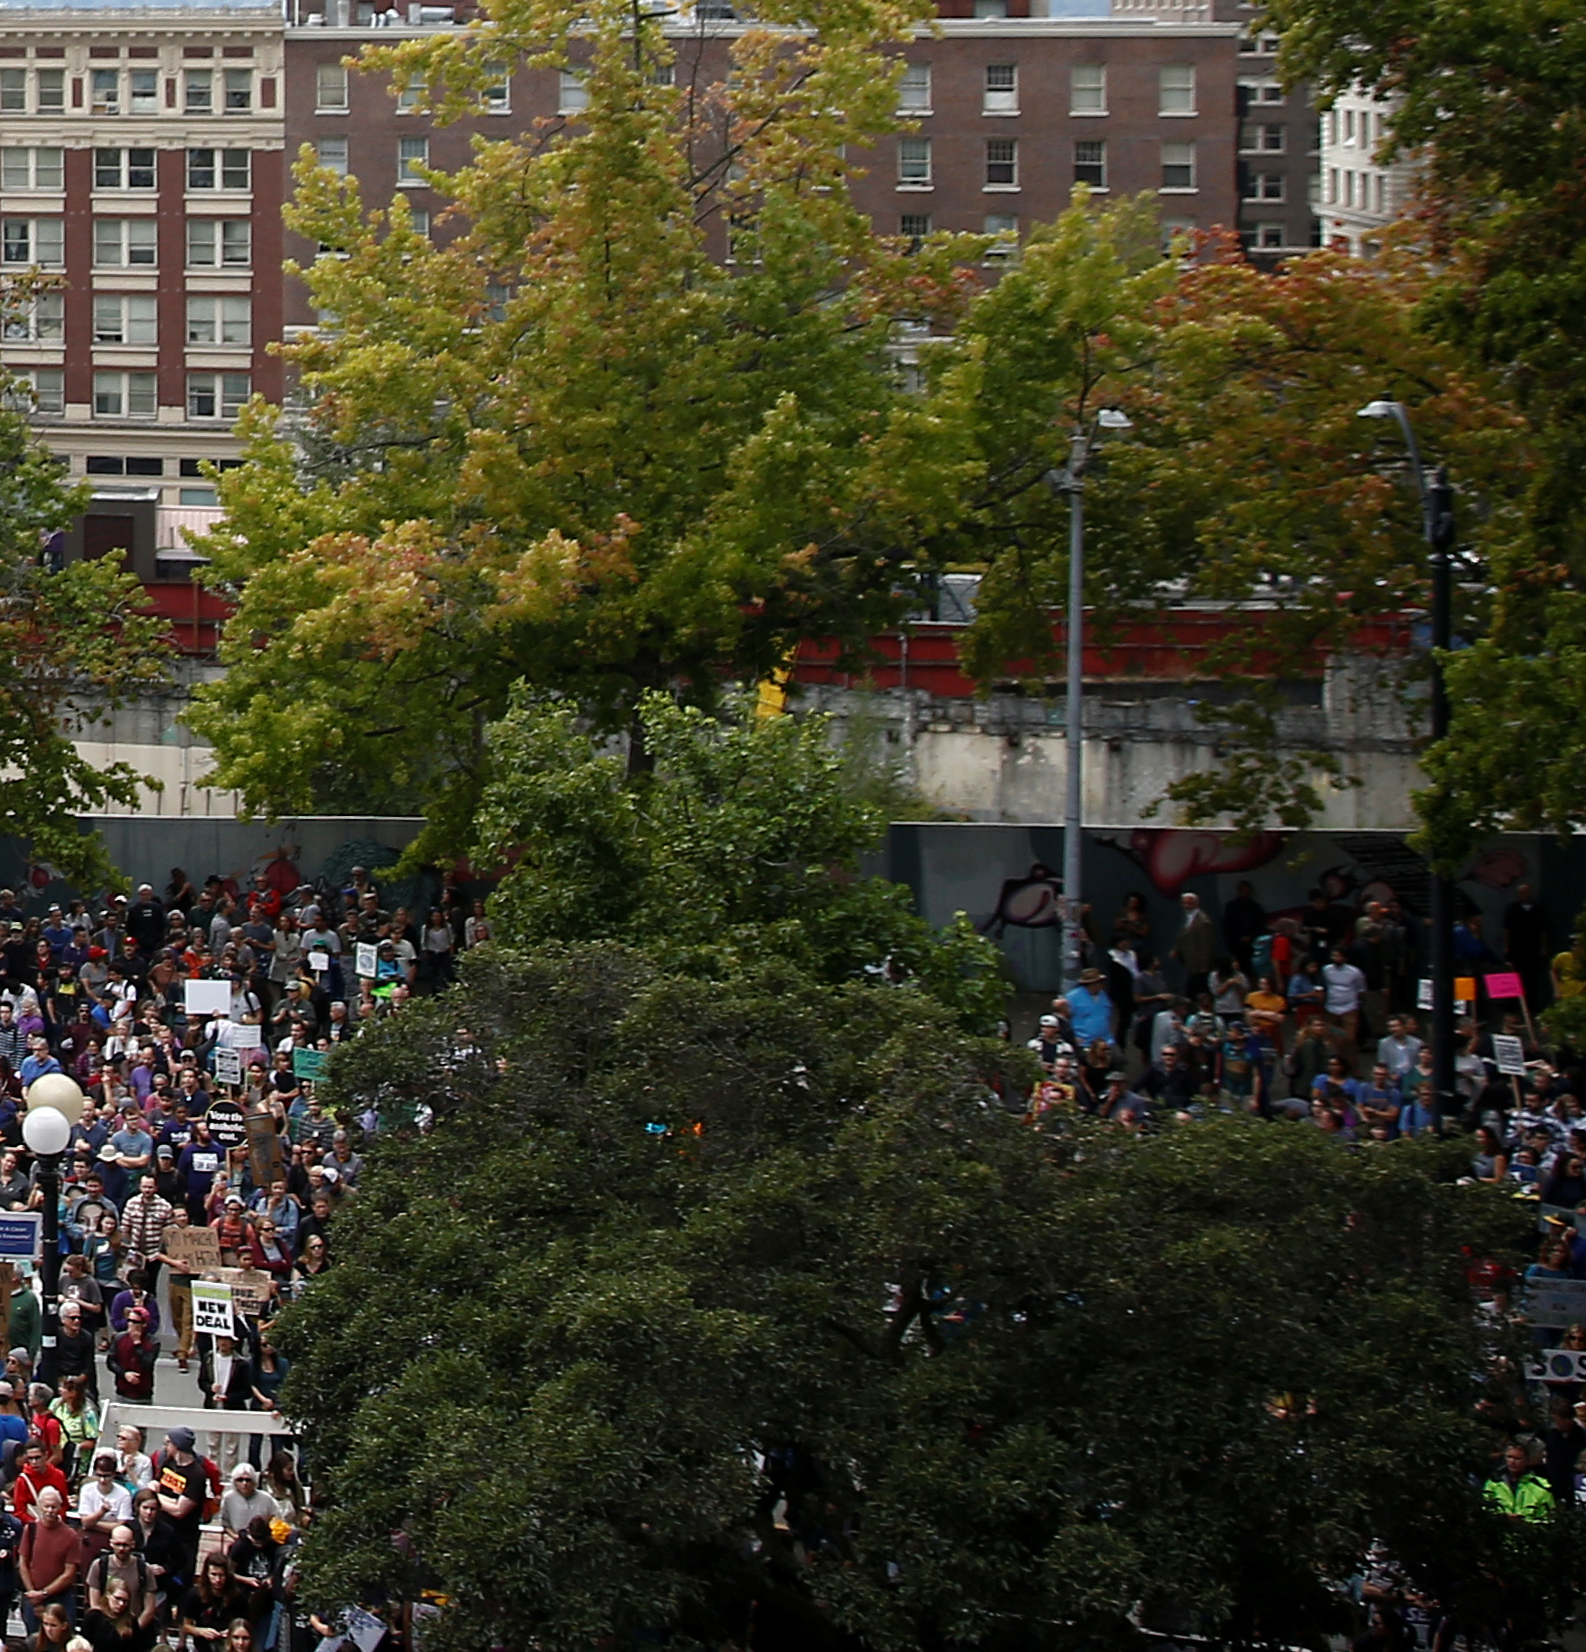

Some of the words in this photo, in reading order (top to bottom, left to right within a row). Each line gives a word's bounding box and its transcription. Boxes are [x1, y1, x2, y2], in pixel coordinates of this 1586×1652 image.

[209, 1110, 230, 1121] Vote
[198, 1301, 226, 1314] NEW
[196, 1315, 231, 1330] DEAL
